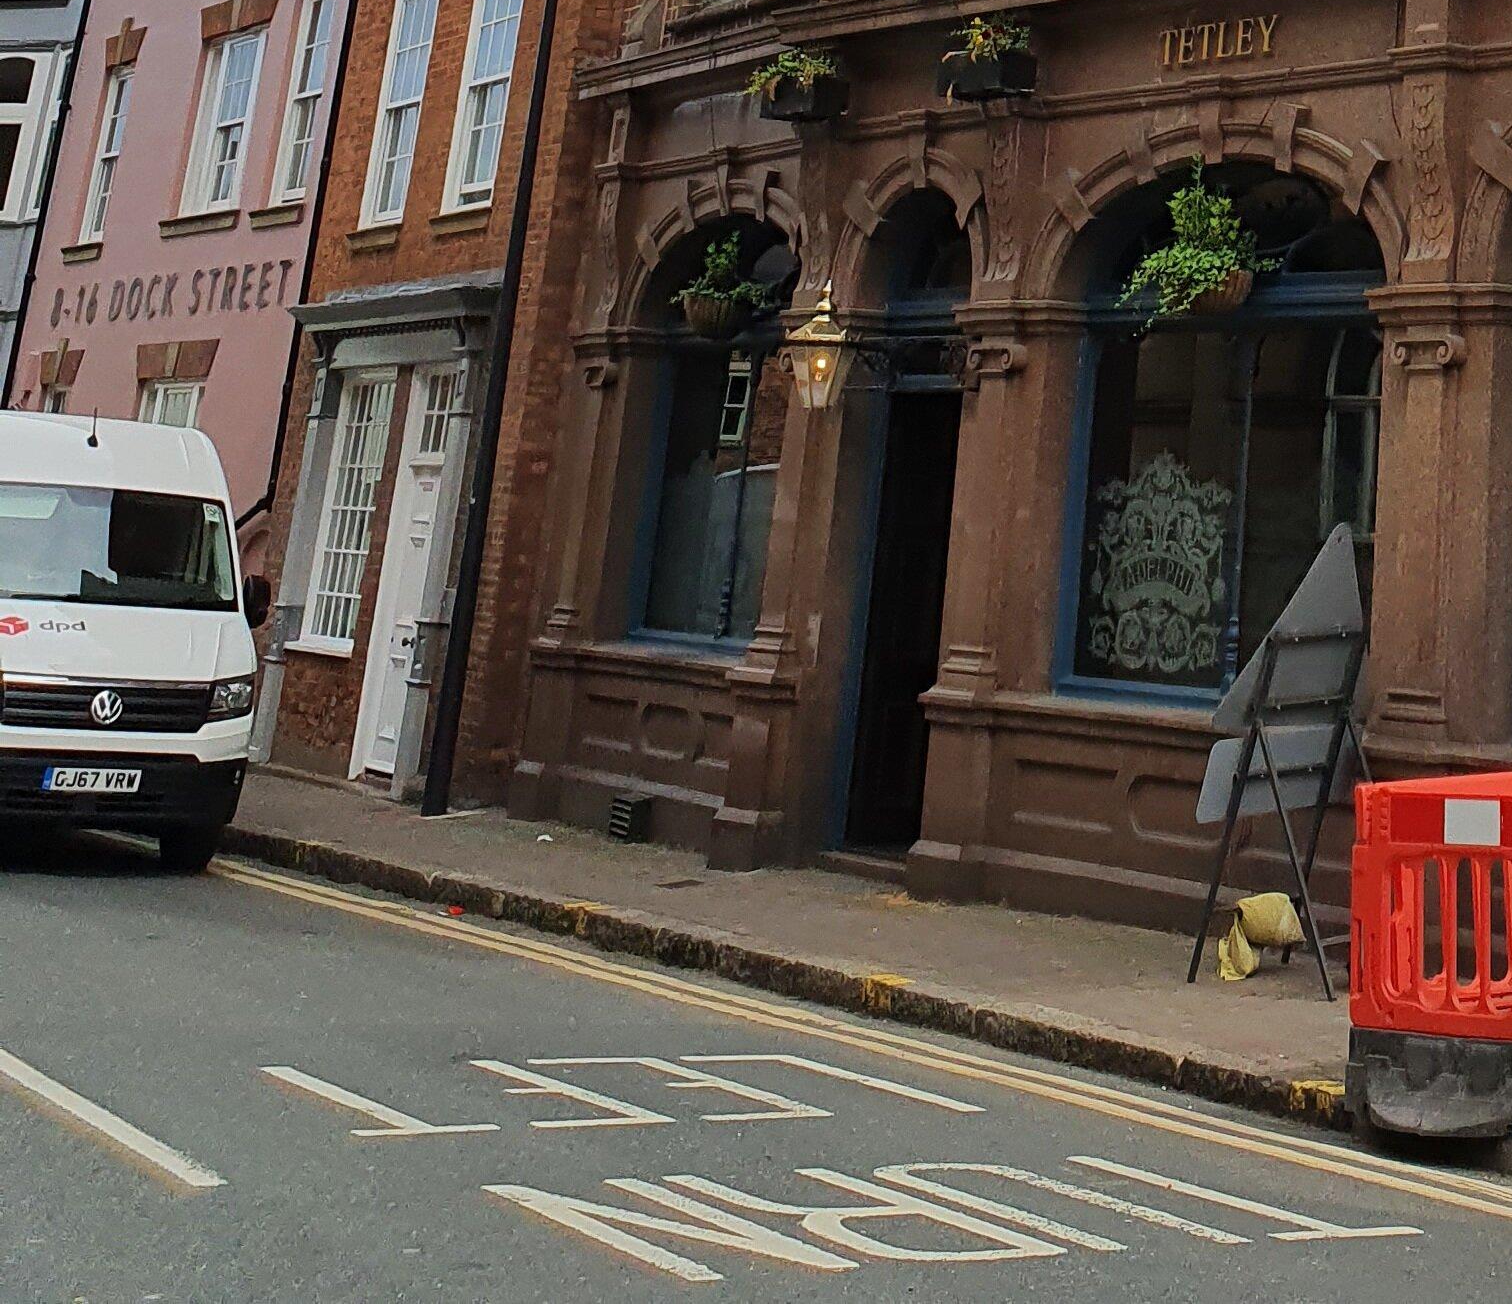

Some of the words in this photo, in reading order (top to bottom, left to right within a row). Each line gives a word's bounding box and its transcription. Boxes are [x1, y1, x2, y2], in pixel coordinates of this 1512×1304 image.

[1160, 13, 1279, 66] TETLEY
[108, 273, 179, 323] DOCK
[187, 259, 293, 317] STREET
[39, 620, 86, 633] dpd
[54, 770, 101, 789] GJ67
[105, 771, 138, 790] VRW
[261, 1054, 987, 1137] LEFT
[482, 1154, 1424, 1281] TURN
